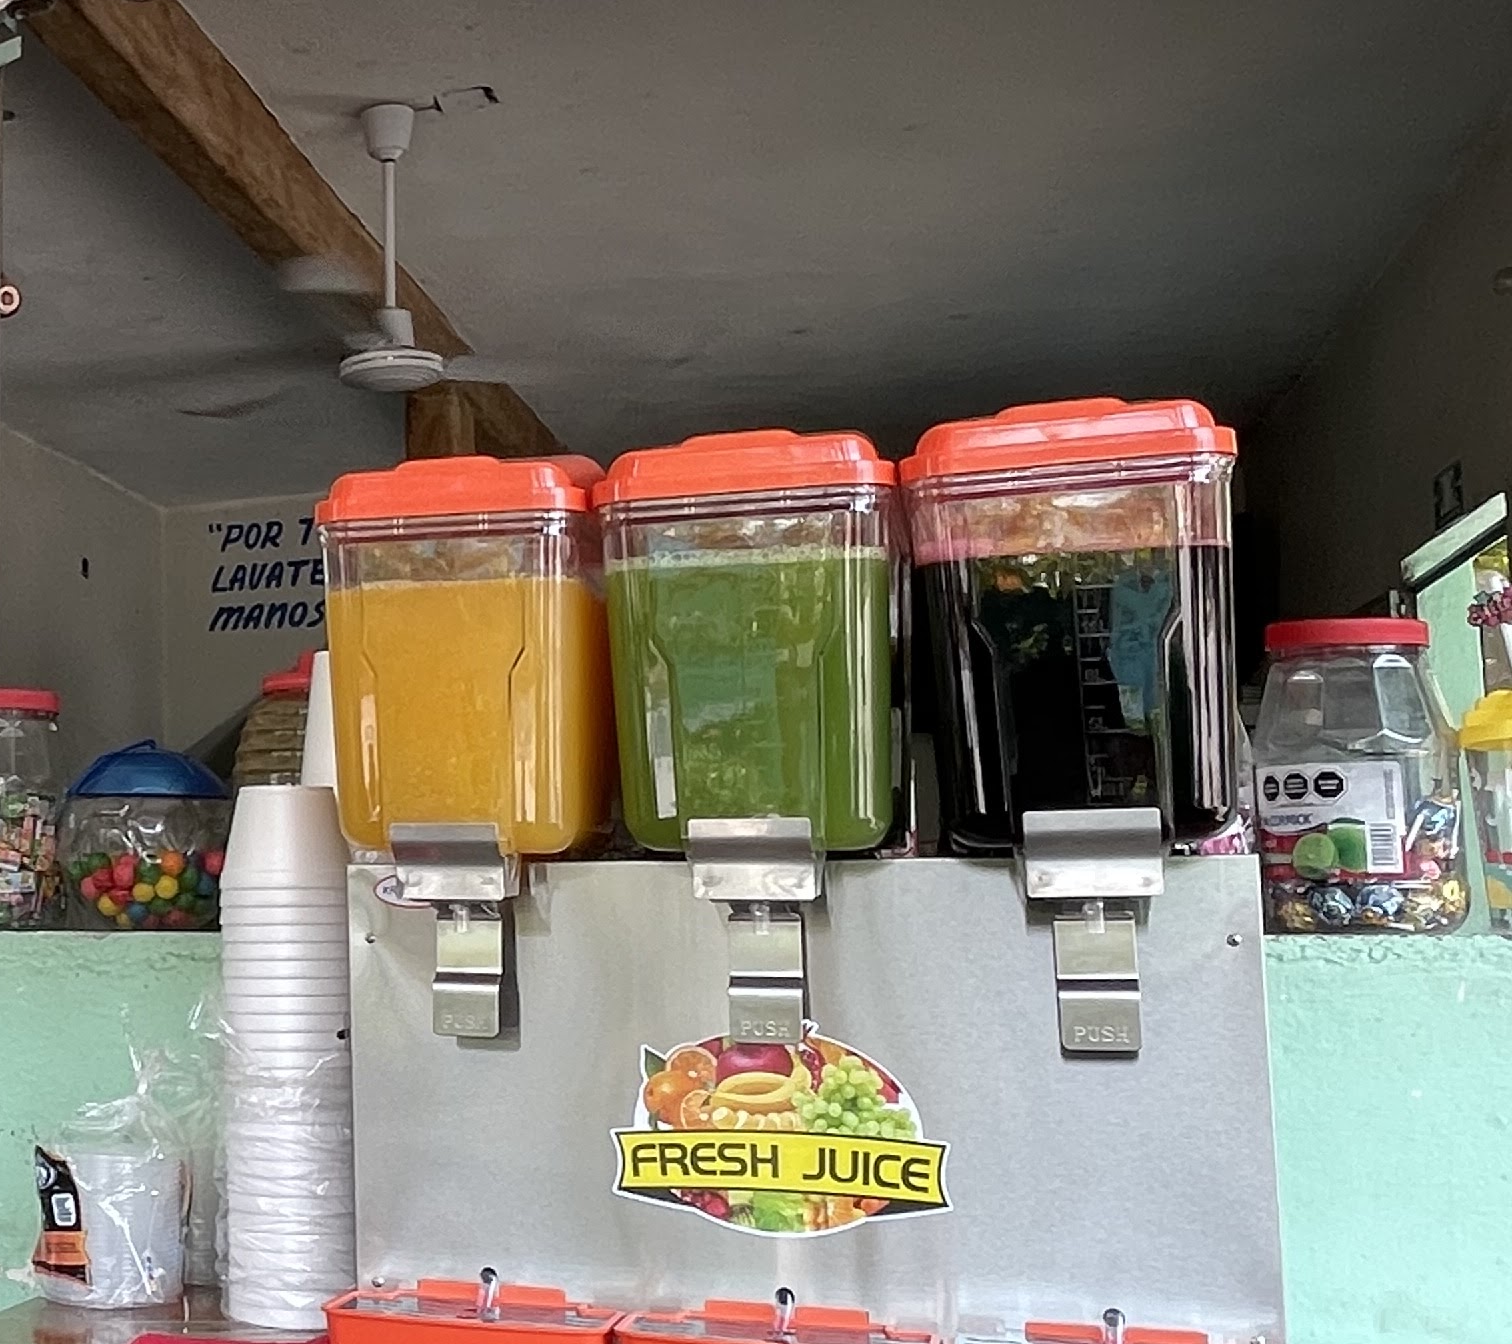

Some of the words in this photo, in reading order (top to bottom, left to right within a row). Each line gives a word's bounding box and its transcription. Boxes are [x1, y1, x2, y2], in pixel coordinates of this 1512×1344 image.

[211, 558, 325, 593] LAVATE
[740, 1019, 791, 1038] PUSH
[1072, 1025, 1131, 1044] PUSH
[632, 1142, 779, 1179] FRESH
[802, 1146, 931, 1194] JUICE
